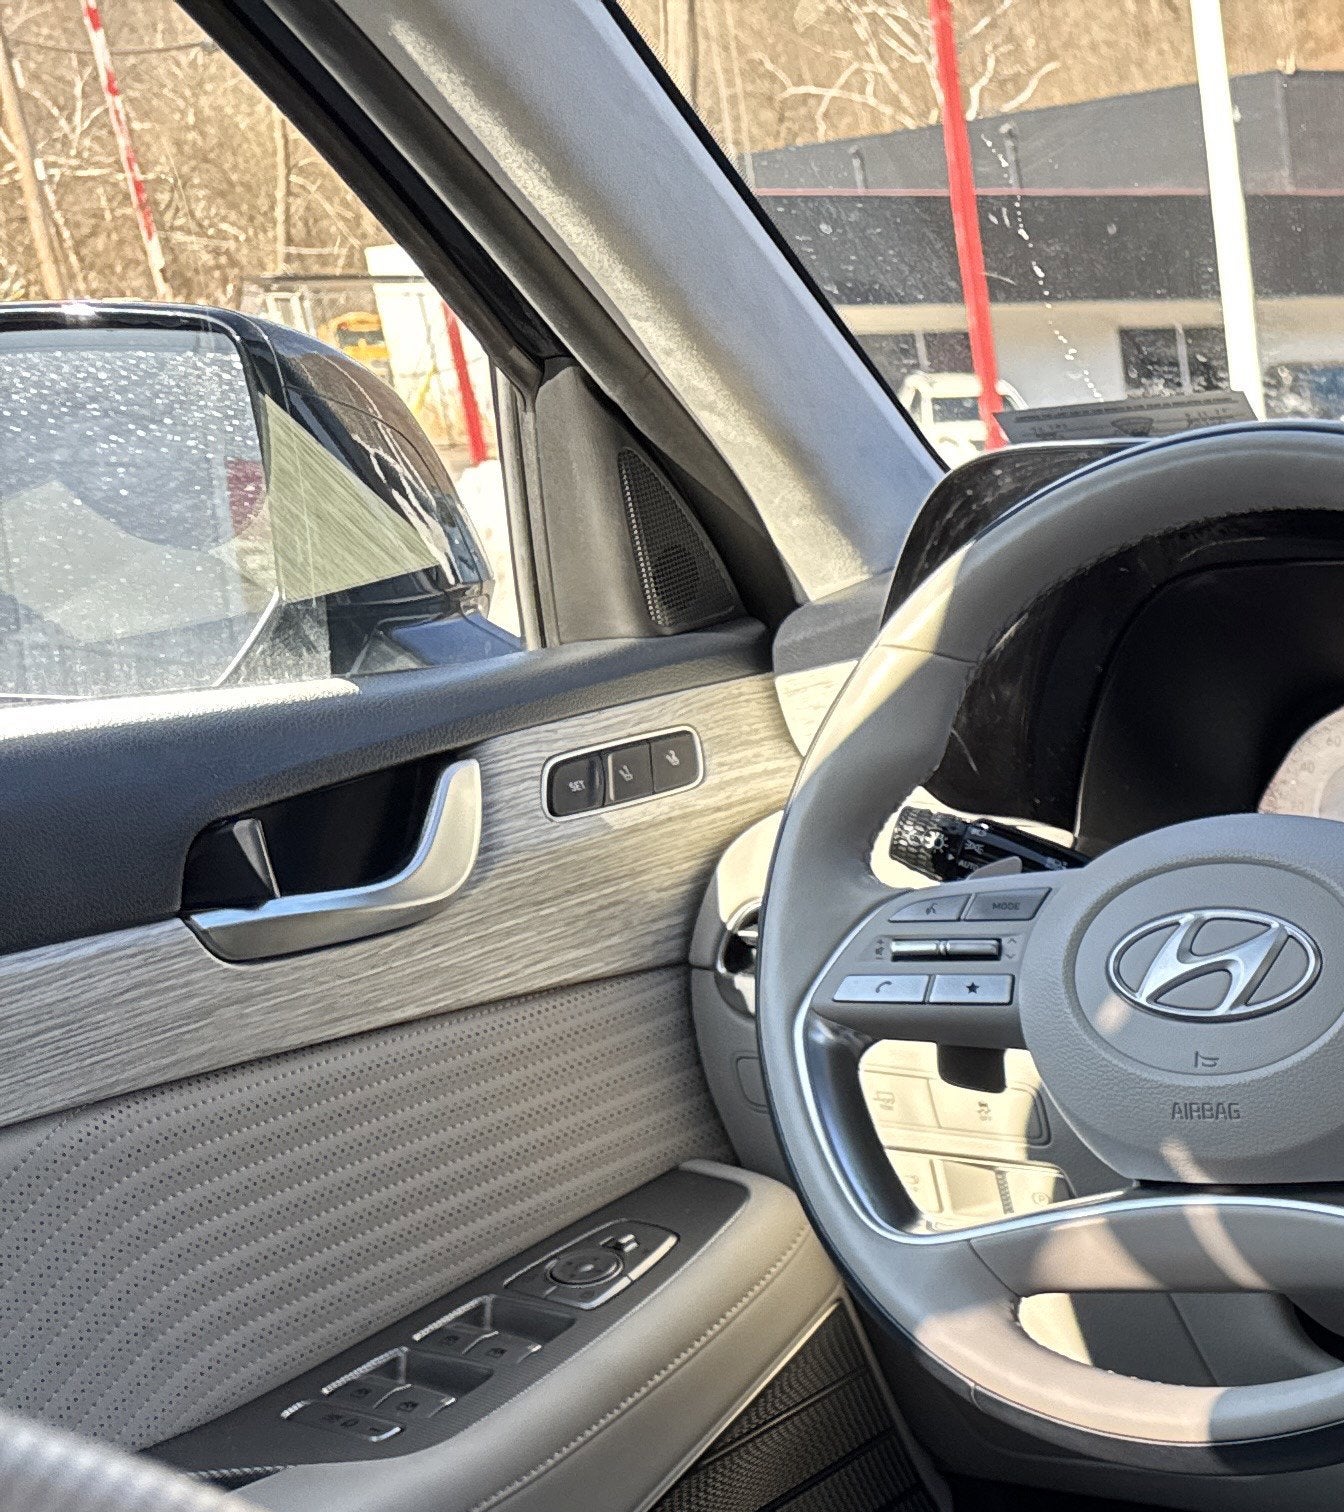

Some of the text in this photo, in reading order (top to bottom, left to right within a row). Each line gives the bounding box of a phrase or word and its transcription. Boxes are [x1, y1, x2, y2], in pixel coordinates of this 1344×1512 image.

[1326, 736, 1341, 747] 60
[569, 779, 586, 792] SET
[992, 903, 1020, 911] MODE
[1171, 1102, 1241, 1120] AIRBAG
